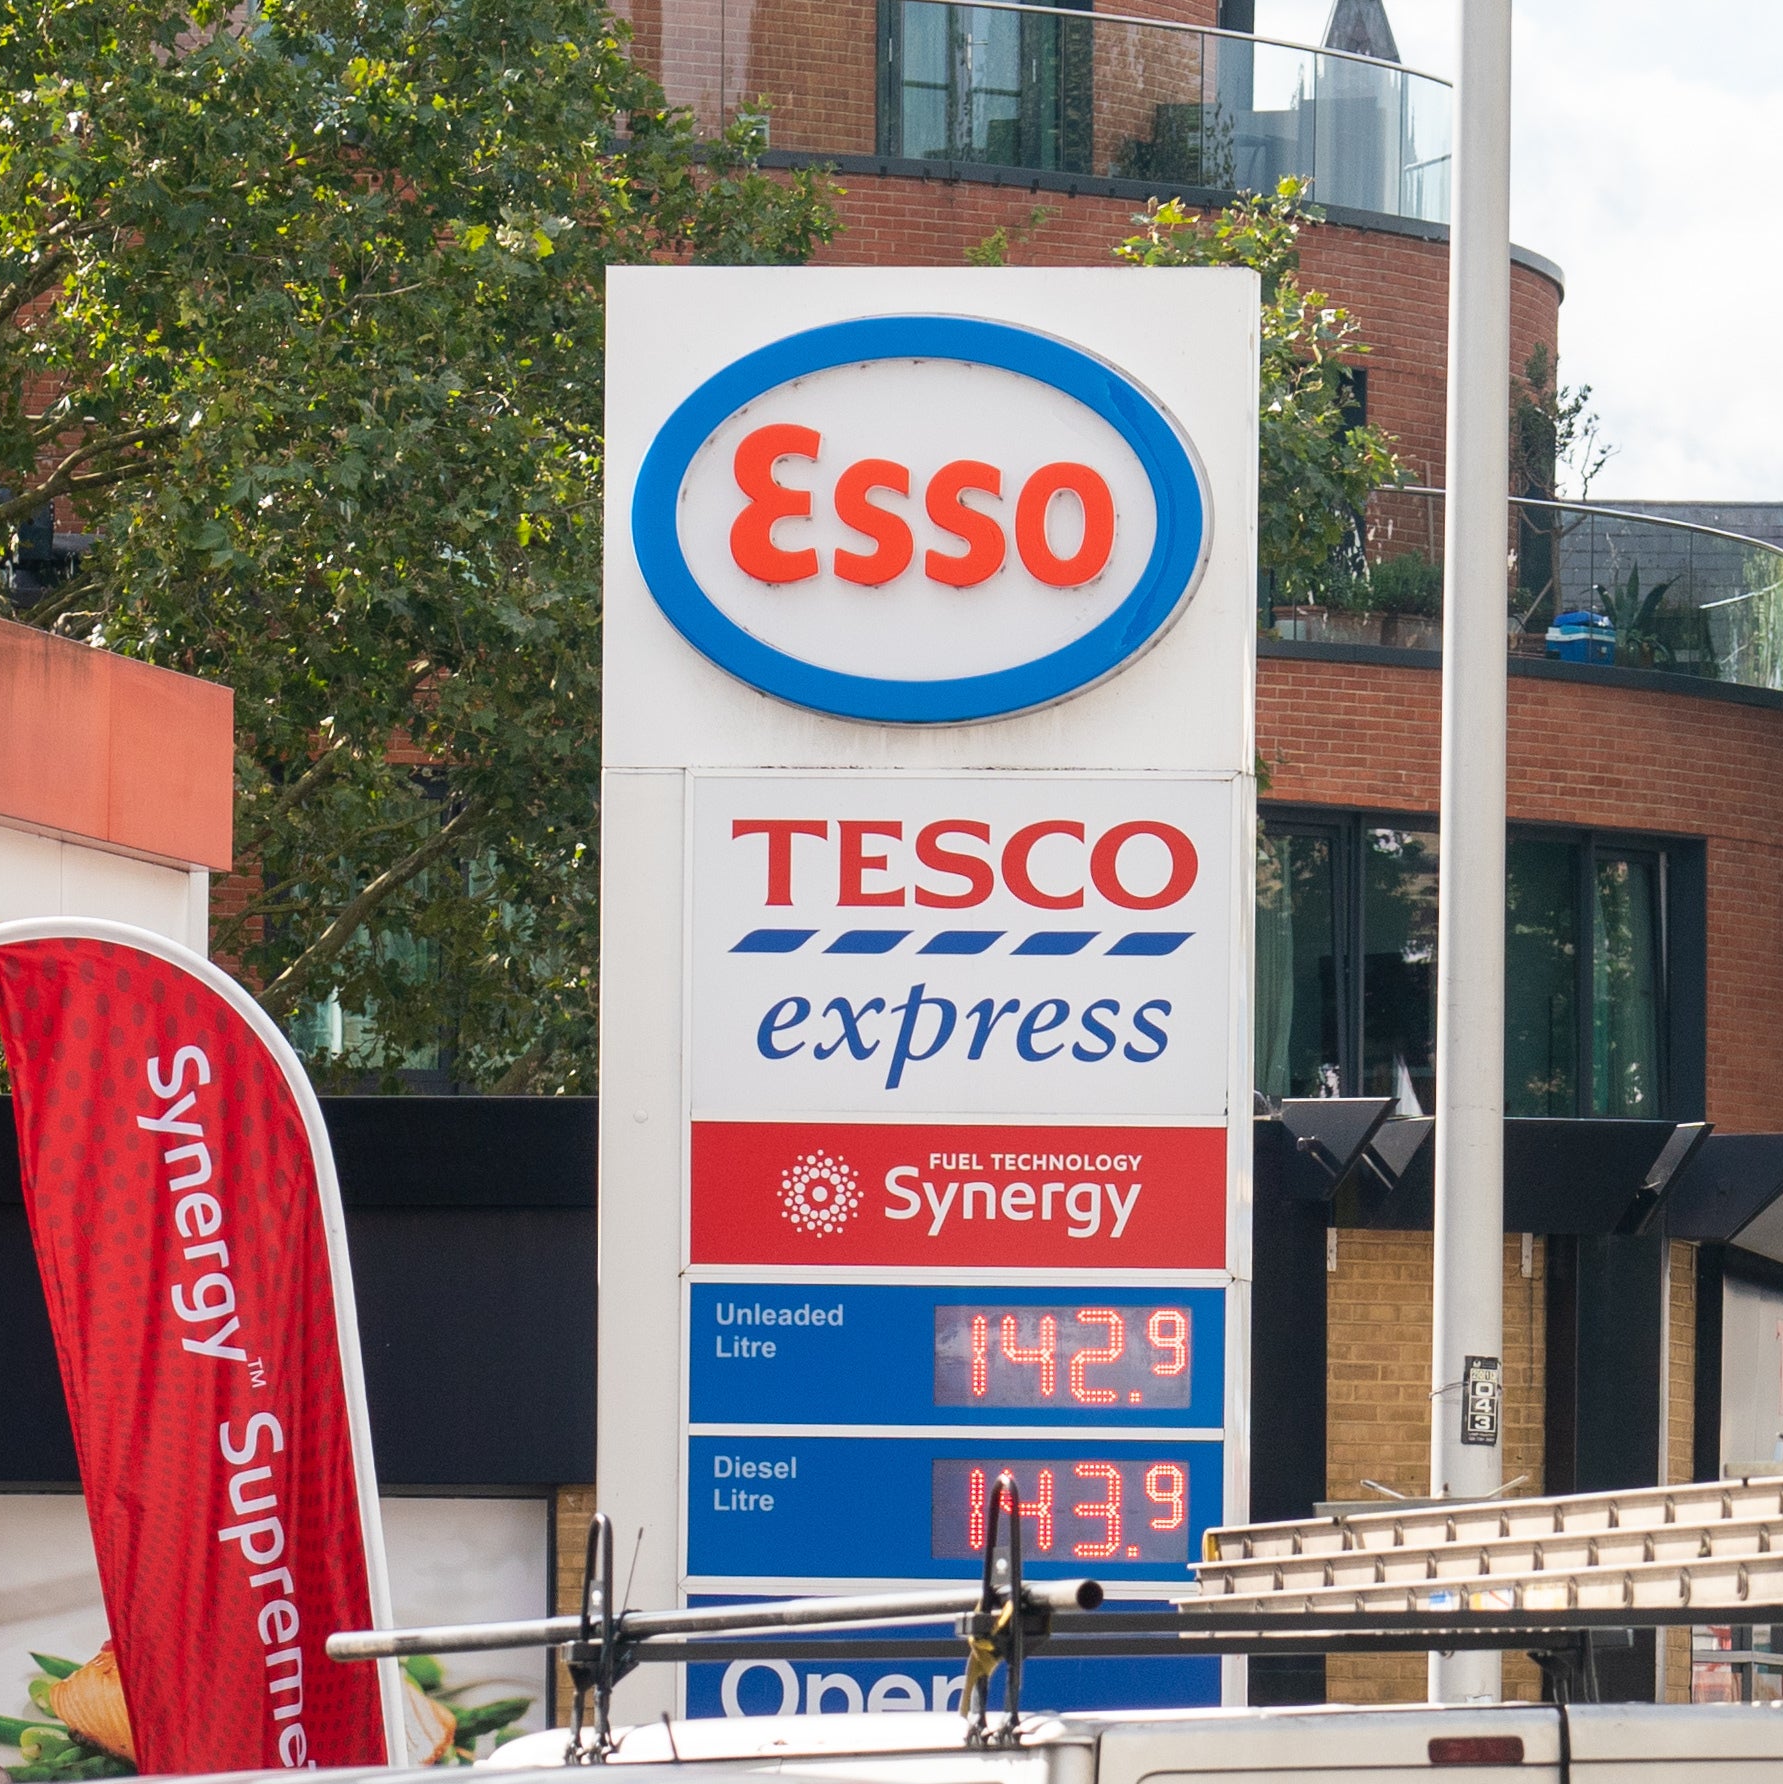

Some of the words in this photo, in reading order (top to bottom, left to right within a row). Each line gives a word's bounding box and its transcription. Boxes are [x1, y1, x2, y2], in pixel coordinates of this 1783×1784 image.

[730, 423, 1116, 588] Esso
[731, 819, 1199, 910] TESCO
[756, 982, 1173, 1090] express
[885, 1165, 1142, 1238] Synergy
[930, 1153, 983, 1171] FUEL
[991, 1154, 1143, 1172] TECHNOLOGY
[716, 1336, 776, 1359] Litre
[716, 1302, 844, 1327] Unleaded
[971, 1309, 1187, 1405] 142.9
[713, 1488, 775, 1512] Litre
[714, 1455, 798, 1479] Diesel
[218, 1408, 308, 1769] Supreme
